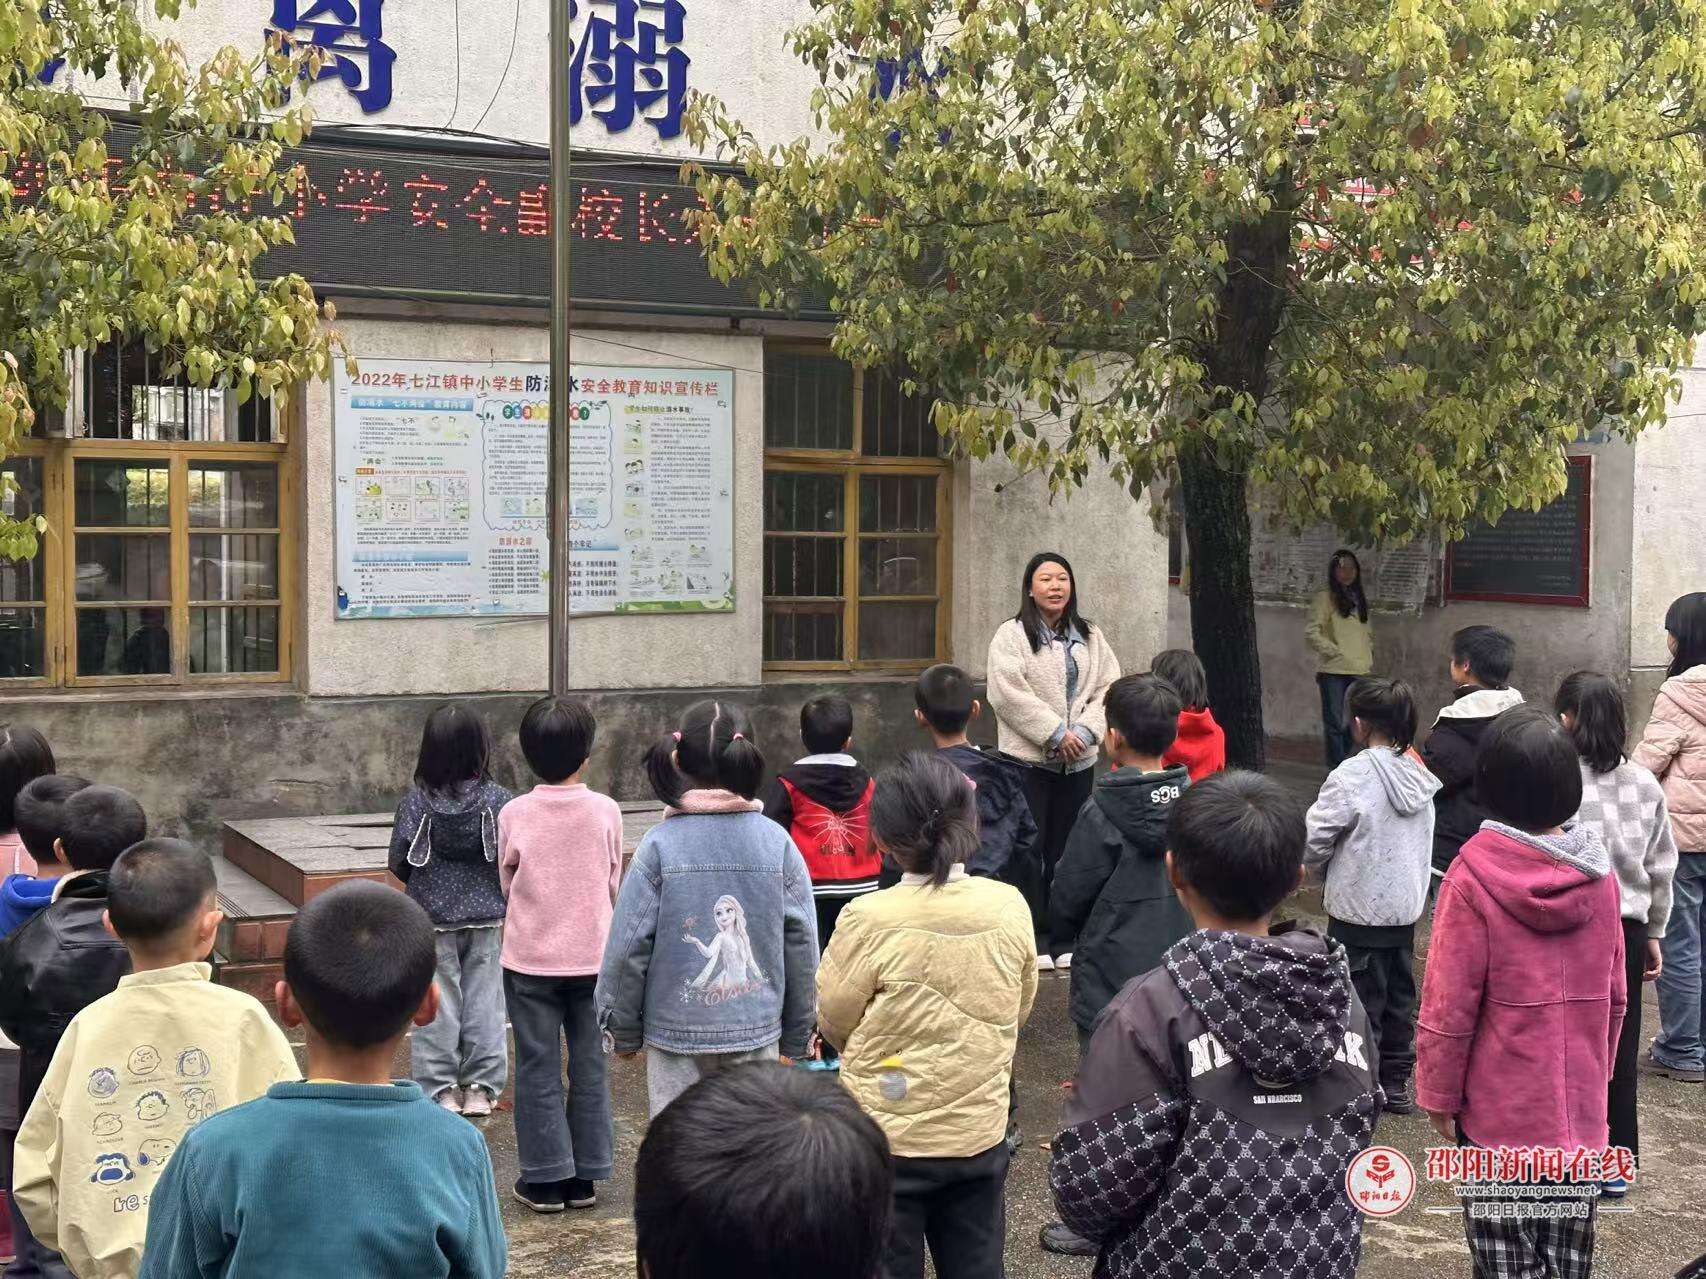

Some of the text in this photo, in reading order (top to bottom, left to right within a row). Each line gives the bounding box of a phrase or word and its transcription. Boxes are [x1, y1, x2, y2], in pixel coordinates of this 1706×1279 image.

[352, 372, 719, 397] 2022年七江镇中小学生防水安全教育知识宣传栏
